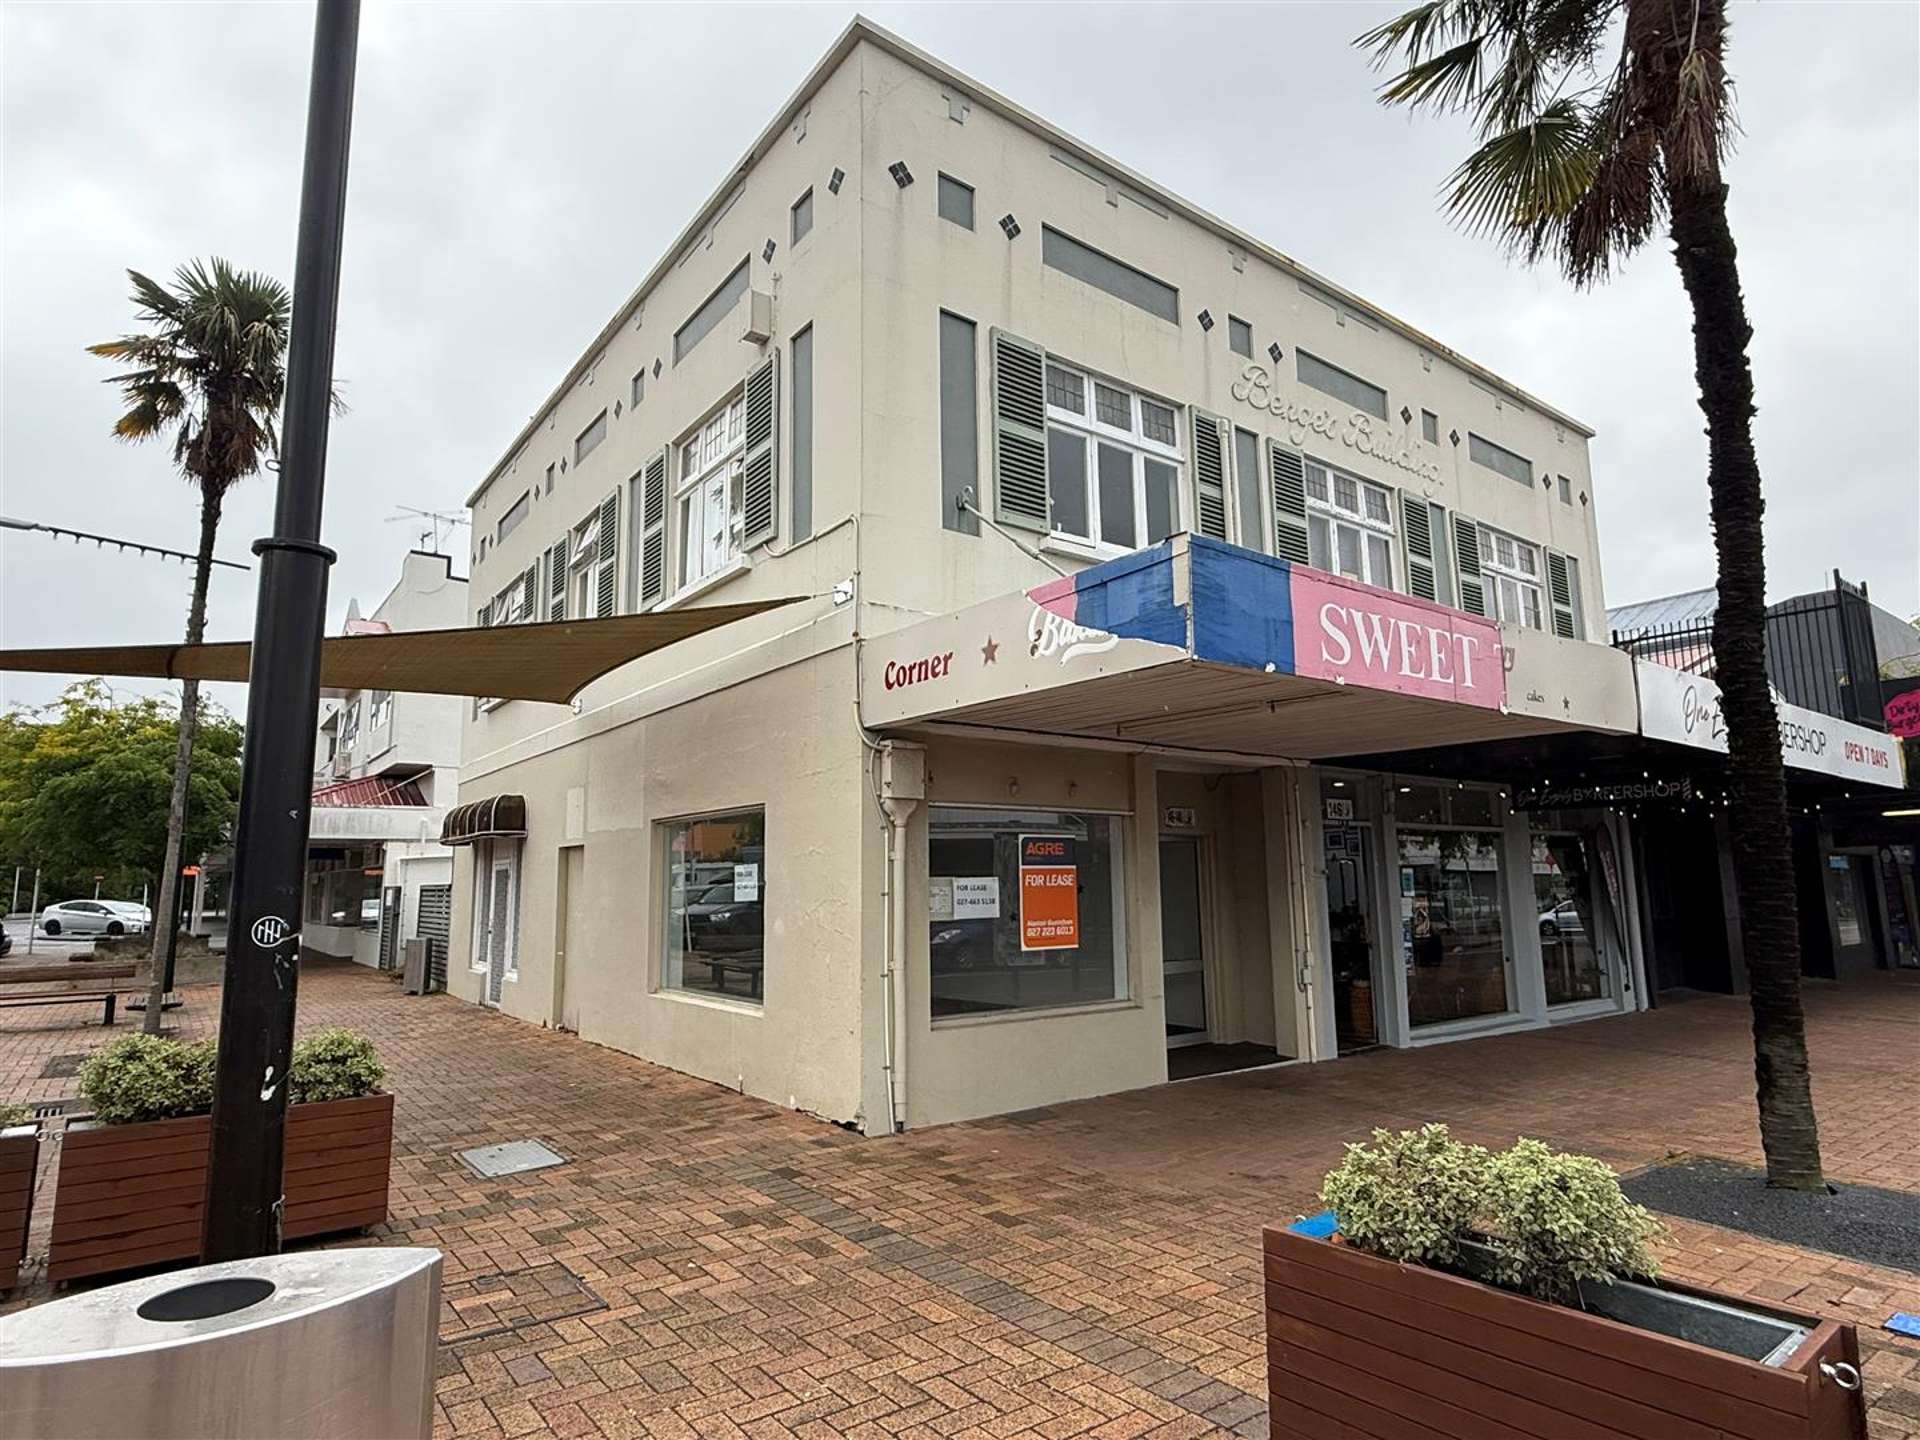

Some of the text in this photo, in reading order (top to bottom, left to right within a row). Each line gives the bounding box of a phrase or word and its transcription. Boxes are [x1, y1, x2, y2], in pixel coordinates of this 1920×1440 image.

[1342, 413, 1445, 498] Building
[1319, 602, 1479, 688] SWEET
[884, 651, 954, 690] Corner
[1844, 740, 1889, 769] OPEN 7 DAYS
[1026, 842, 1064, 856] AGRE
[956, 884, 969, 892] FOR
[1025, 874, 1075, 887] FOR LEASE
